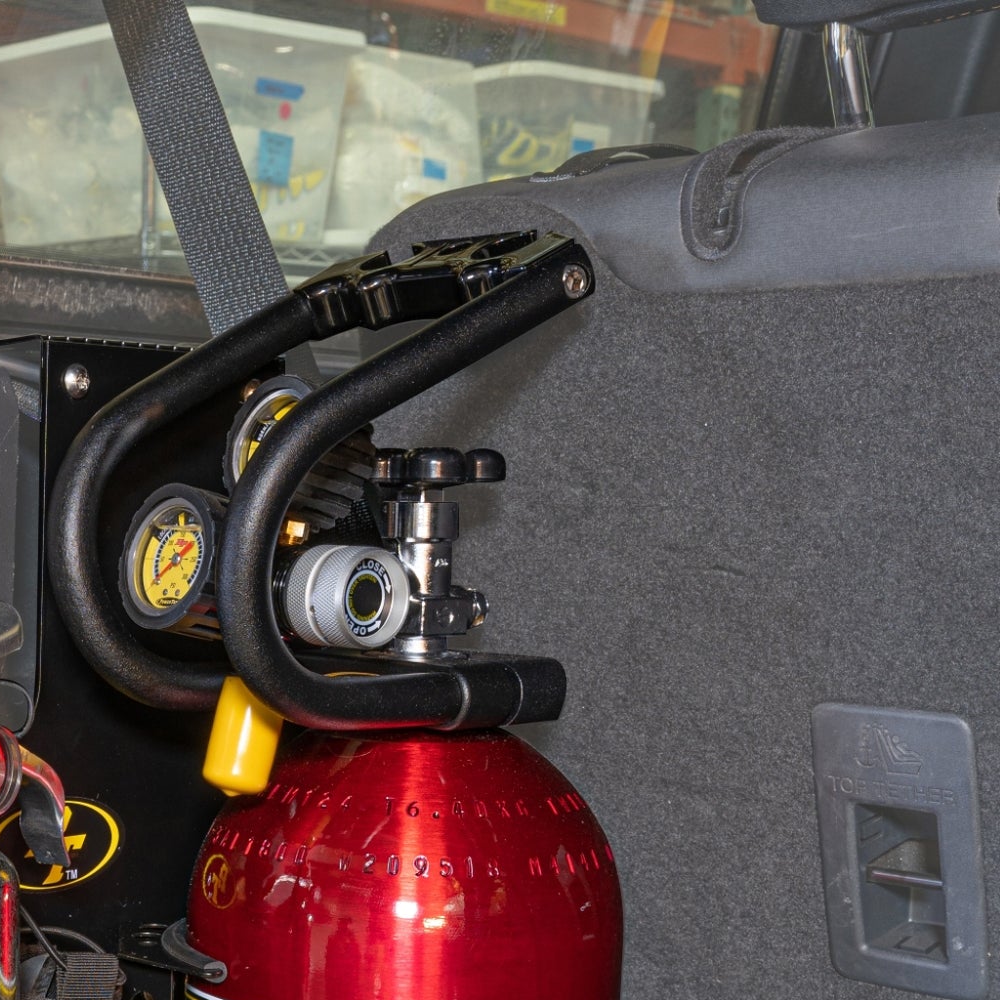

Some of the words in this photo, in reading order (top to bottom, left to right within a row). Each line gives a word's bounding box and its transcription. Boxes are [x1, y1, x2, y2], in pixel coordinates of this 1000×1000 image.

[356, 560, 385, 576] CLOSE
[828, 775, 866, 795] TOP
[872, 781, 956, 806] TETHER
